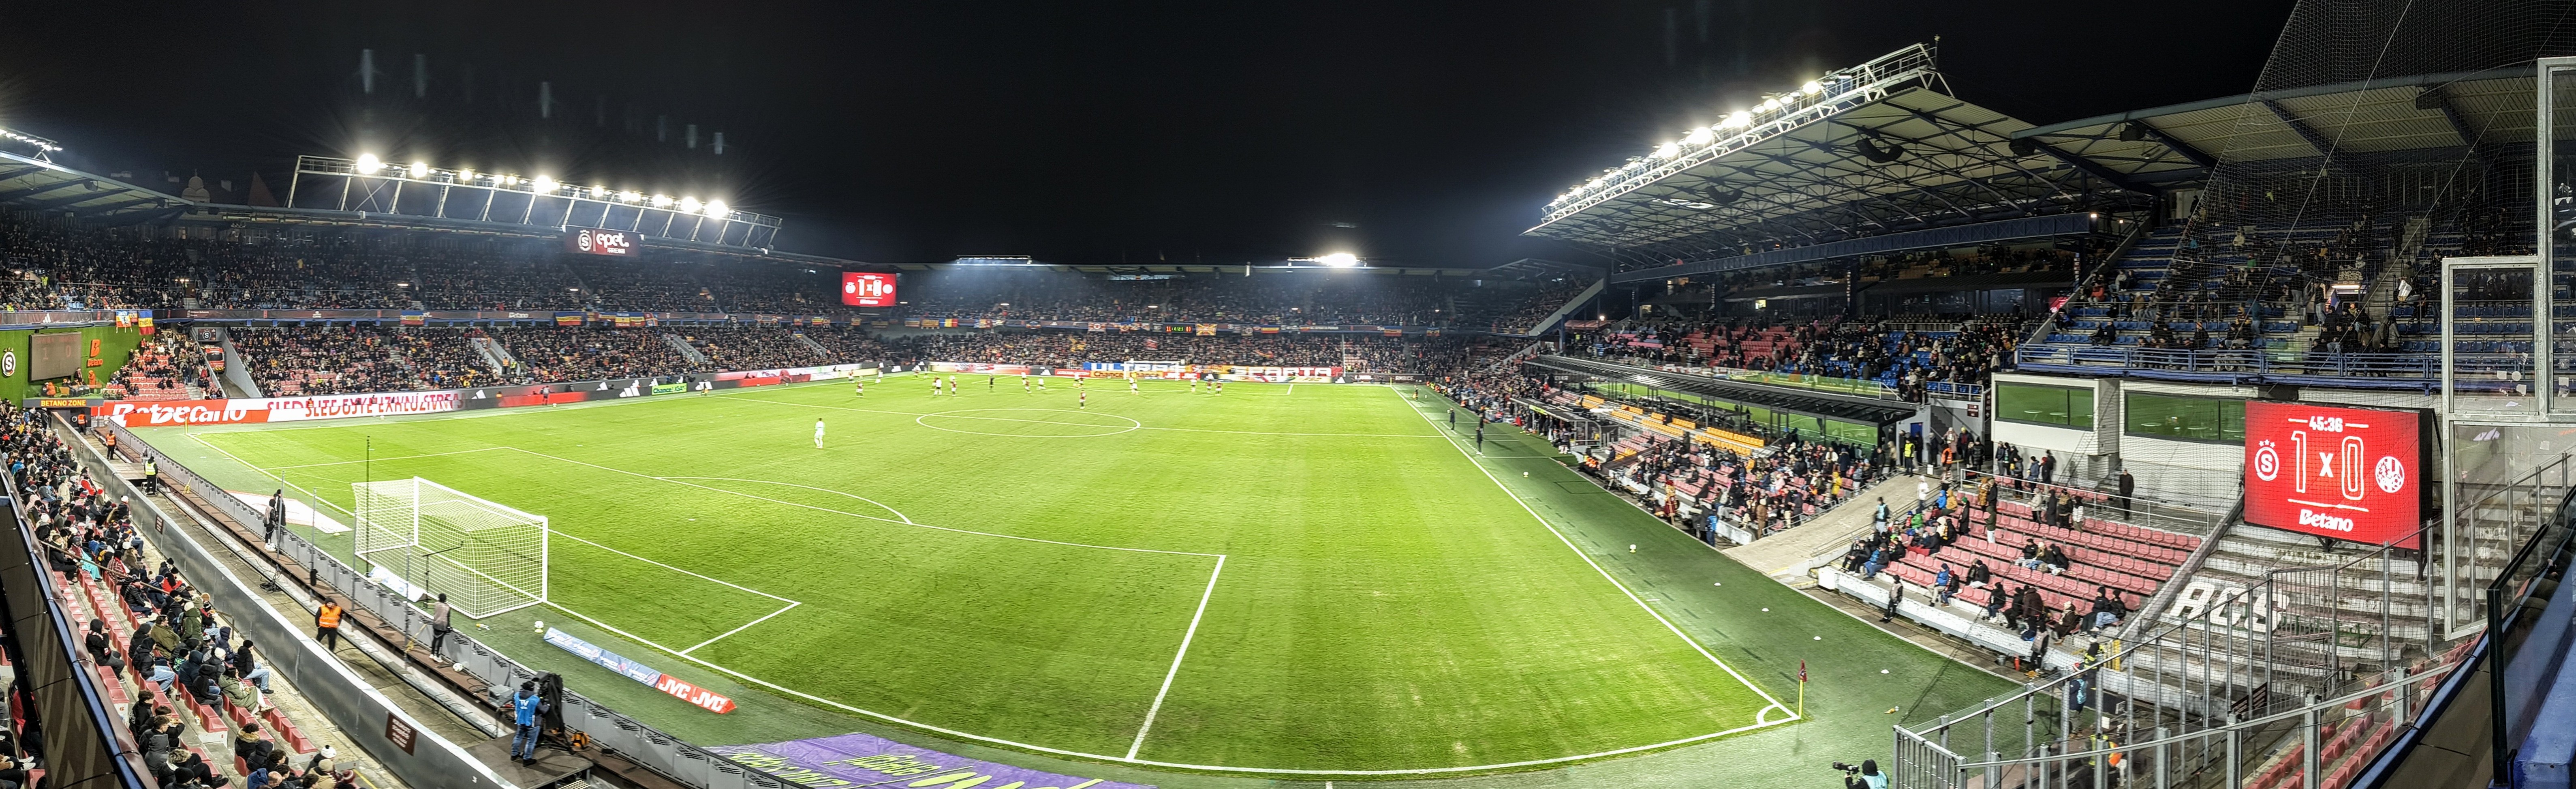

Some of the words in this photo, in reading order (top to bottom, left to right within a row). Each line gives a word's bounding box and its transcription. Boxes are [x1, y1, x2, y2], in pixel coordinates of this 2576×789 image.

[2309, 416, 2343, 433] 45:36
[2291, 430, 2307, 494] 1
[2341, 435, 2364, 500] 0
[2298, 508, 2354, 532] Betano
[658, 679, 691, 700] JVC
[691, 692, 727, 711] JVC
